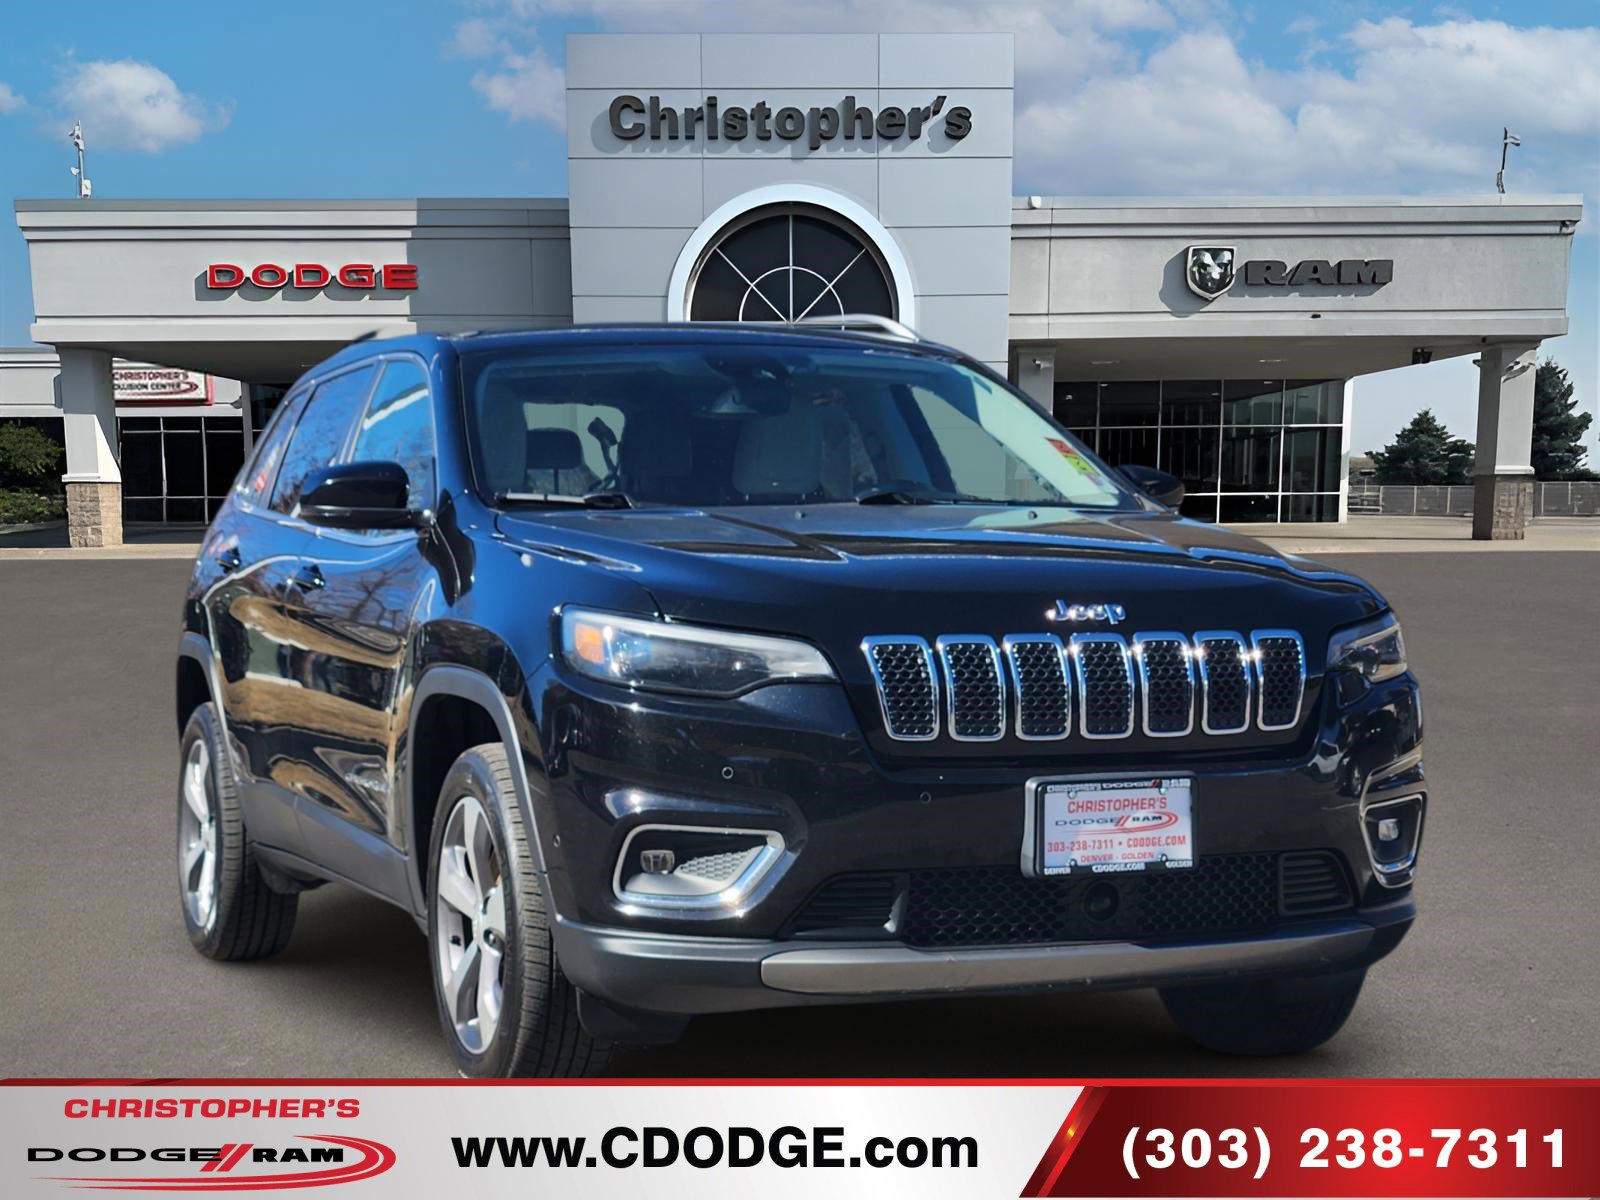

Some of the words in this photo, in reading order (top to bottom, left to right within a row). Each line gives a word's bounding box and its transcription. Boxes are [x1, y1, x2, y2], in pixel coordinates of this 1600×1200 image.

[609, 95, 972, 150] Christopher's
[207, 263, 417, 289] DODGE
[1245, 260, 1393, 285] RAM
[1045, 600, 1126, 624] Jeep
[1067, 797, 1167, 814] CHRISTOPHER'S
[1055, 817, 1120, 826] DODGE
[1047, 839, 1114, 852] 303-238-7311
[1121, 852, 1154, 860] GOLDEN
